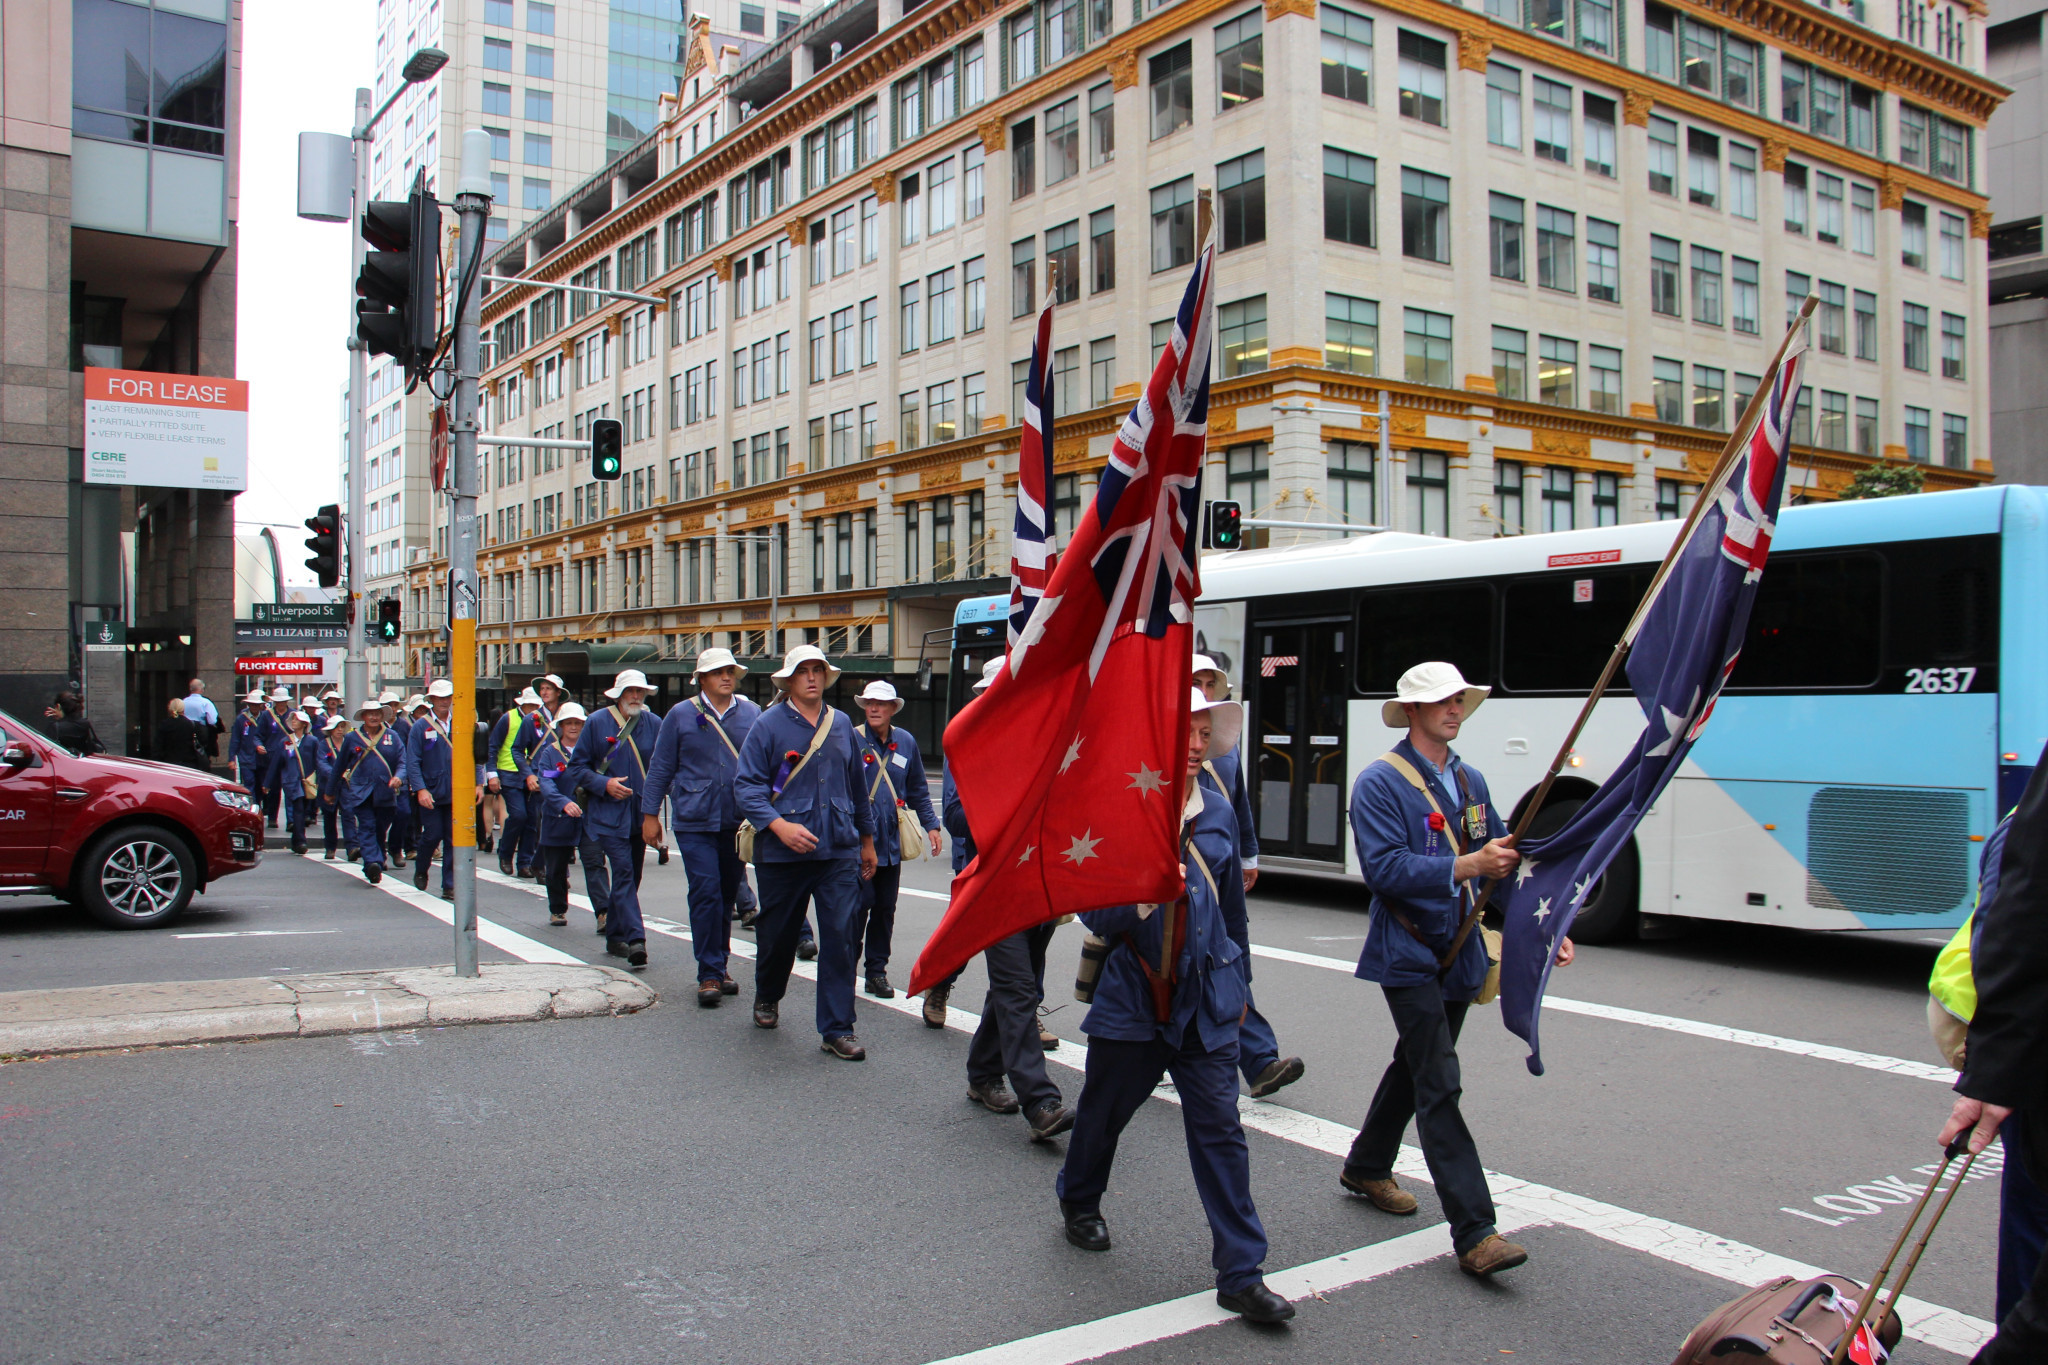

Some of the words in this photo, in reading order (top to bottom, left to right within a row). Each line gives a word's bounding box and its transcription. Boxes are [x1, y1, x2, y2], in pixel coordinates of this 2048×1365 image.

[108, 377, 154, 398] FOR
[160, 382, 227, 404] LEASE
[99, 404, 123, 413] LAST
[124, 406, 174, 417] REMAINING
[175, 410, 201, 419] SUITE
[99, 417, 148, 428] PARTIALLY
[149, 420, 179, 430] FITTED
[180, 423, 206, 432] SUITE
[99, 430, 123, 439] VERY
[124, 432, 165, 442] FLEXIBLE
[167, 435, 195, 444] LEASE
[197, 436, 227, 446] TERMS
[91, 451, 127, 462] CBRE
[431, 431, 447, 467] STOP
[1550, 554, 1599, 566] EMERGENCY
[1601, 551, 1619, 561] EXIT
[271, 605, 321, 618] Liverpool
[323, 605, 334, 616] St
[962, 608, 978, 619] 2637
[255, 628, 271, 637] 130
[274, 628, 333, 638] ELIZABETH
[239, 662, 277, 671] FLIGHT
[278, 662, 318, 671] CENTRE
[1904, 667, 1977, 693] 2637
[1779, 1174, 1949, 1227] LOOK
